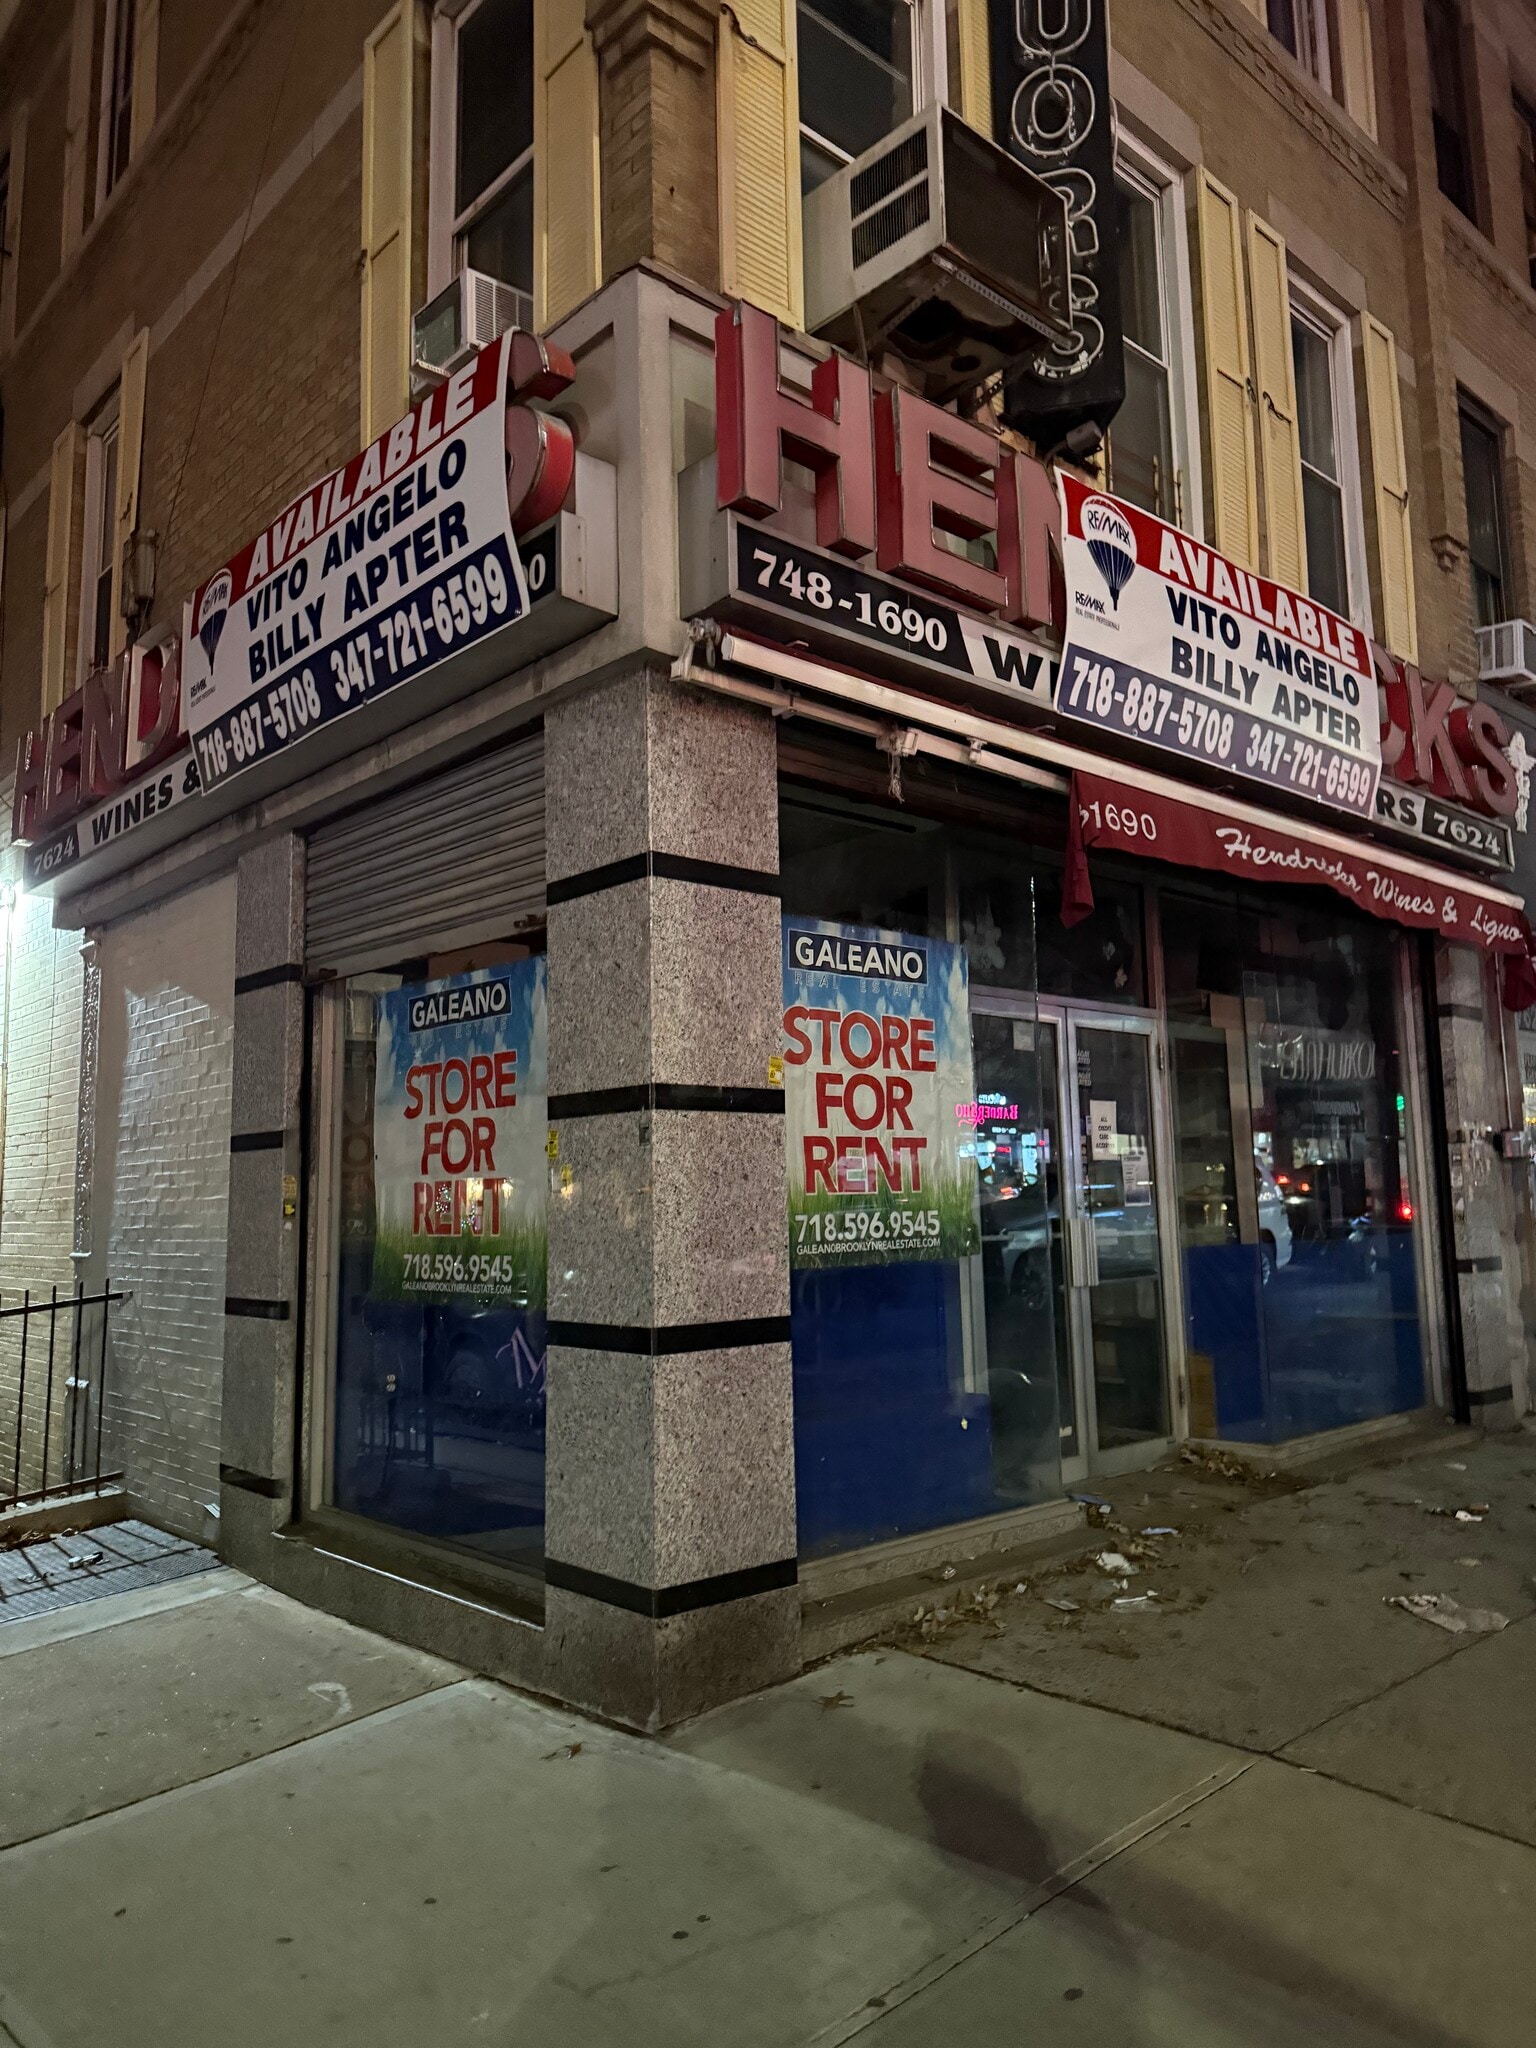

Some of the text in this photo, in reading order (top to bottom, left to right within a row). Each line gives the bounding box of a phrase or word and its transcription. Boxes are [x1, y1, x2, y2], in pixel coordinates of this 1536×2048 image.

[244, 355, 479, 591] AVAILABLE
[247, 438, 467, 632] VITO ANGELO
[1087, 510, 1131, 549] RE/MAX
[248, 501, 469, 685] BILLY APTER
[753, 548, 947, 652] 748-1690
[1075, 591, 1105, 615] RE/MAX
[1159, 529, 1359, 669] AVAILABLE
[198, 552, 508, 782] 718-887-5708 347-721-6599
[1165, 585, 1358, 706] VITO ANGELO
[1171, 636, 1361, 749] BILLY APTER
[1068, 656, 1371, 809] 718-887-5708 347-721-6599
[33, 835, 75, 876] 7624
[92, 774, 173, 845] WINES
[1376, 786, 1501, 855] RS 7624
[1366, 871, 1436, 915] Wines
[1441, 896, 1458, 924] &
[794, 935, 924, 979] GALEANO
[411, 982, 507, 1028] GALEANO
[783, 1005, 937, 1073] STORE
[403, 1049, 517, 1120] STORE
[815, 1072, 914, 1131] FOR
[420, 1116, 496, 1176] FOR
[802, 1135, 928, 1195] RENT
[412, 1177, 505, 1238] RENT
[794, 1210, 941, 1244] 718.596.9545
[402, 1253, 514, 1283] 718.596.9545
[796, 1236, 942, 1256] GALEANOBROOKLYNREALESTATE.COM
[401, 1280, 512, 1295] GALEANOBROOKLYNREALESTATE.COM
